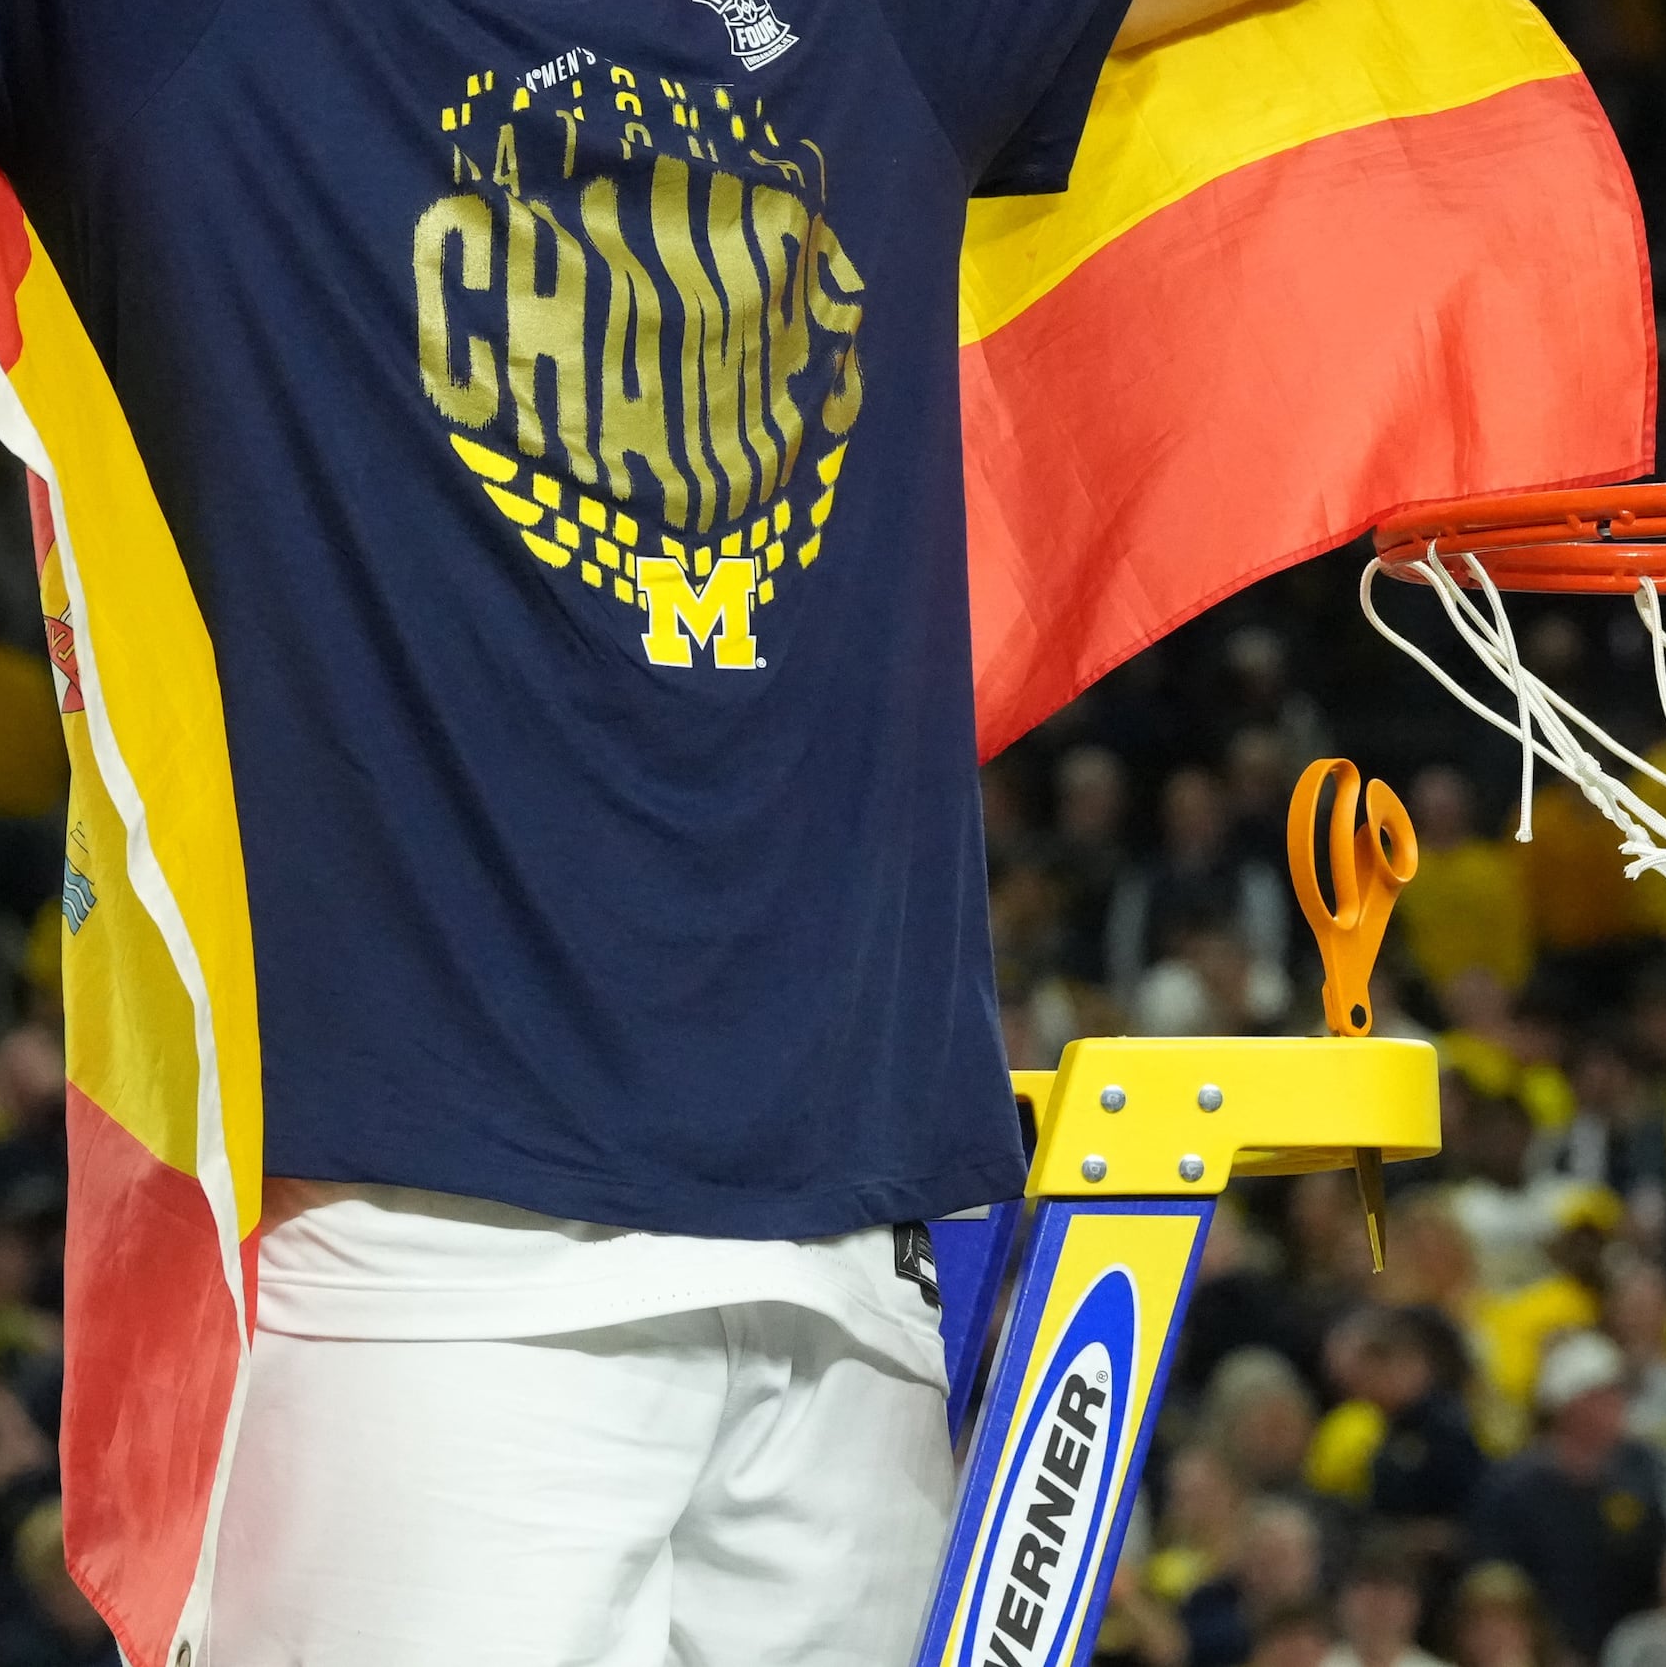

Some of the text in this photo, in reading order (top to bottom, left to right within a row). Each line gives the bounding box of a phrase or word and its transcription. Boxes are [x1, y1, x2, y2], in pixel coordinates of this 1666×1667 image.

[540, 45, 597, 89] MEN'S
[735, 14, 781, 51] FOUR
[412, 152, 866, 535] CHAMPS
[636, 556, 757, 670] M
